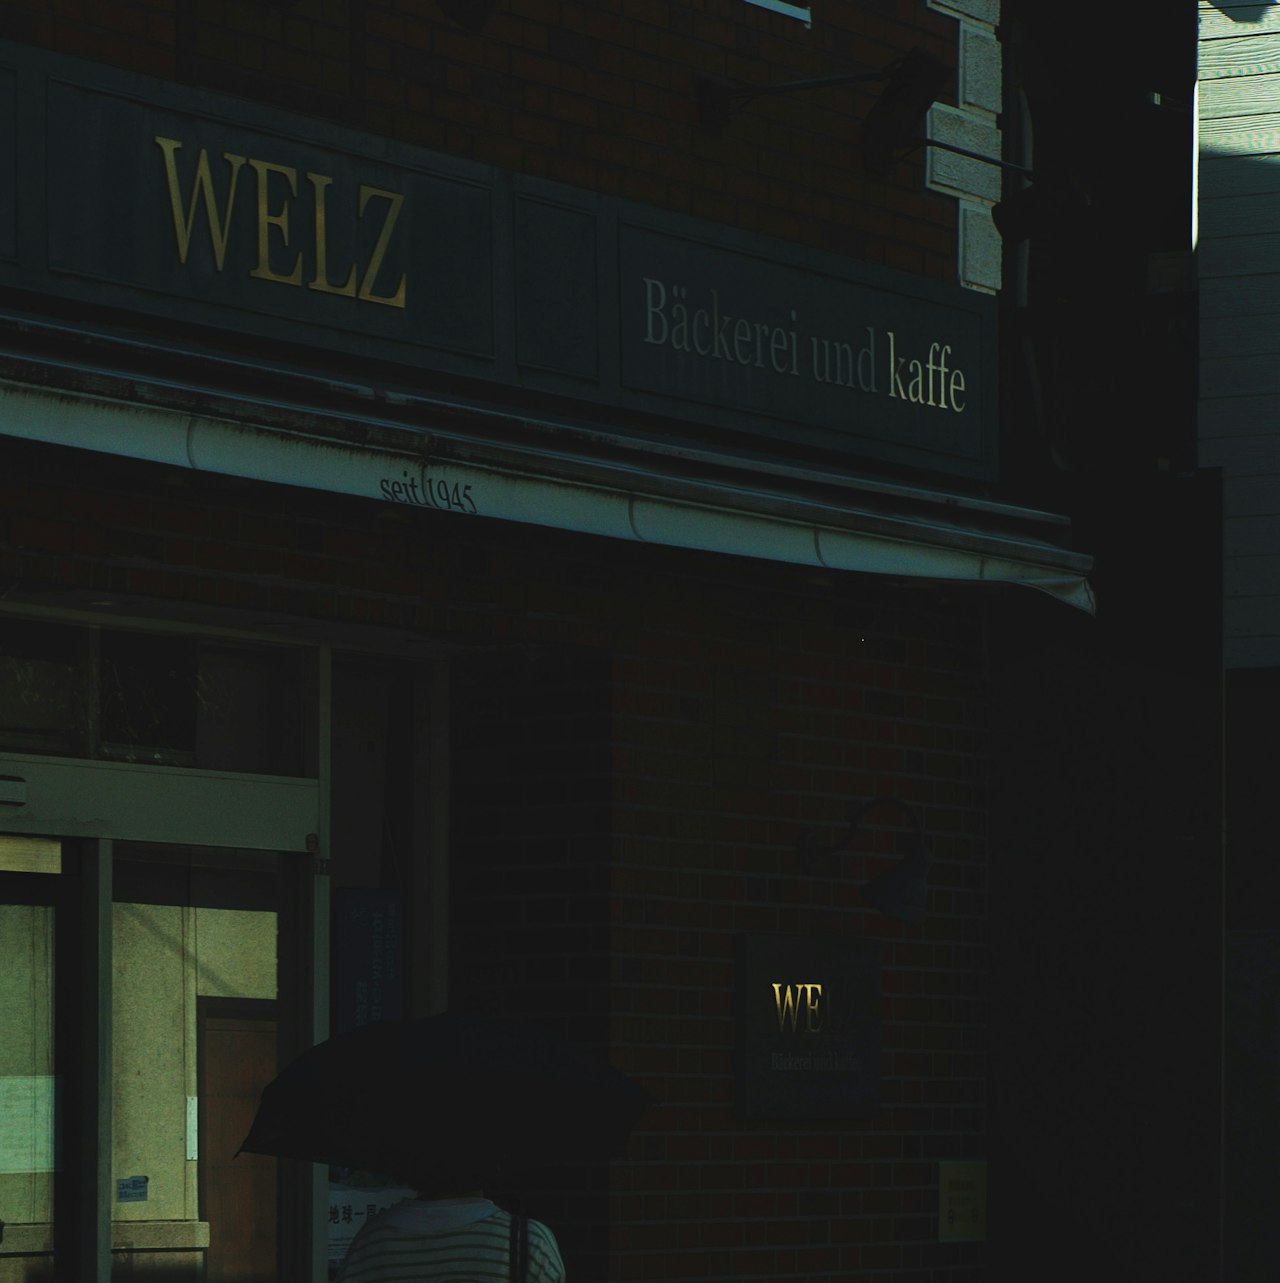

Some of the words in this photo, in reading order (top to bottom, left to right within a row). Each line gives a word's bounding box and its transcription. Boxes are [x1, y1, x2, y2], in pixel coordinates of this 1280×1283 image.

[153, 134, 407, 309] WELZ
[642, 276, 801, 376] Bäckerei
[810, 326, 879, 393] und
[886, 331, 966, 413] kaffe
[379, 470, 419, 504] seit
[427, 478, 478, 514] 1945
